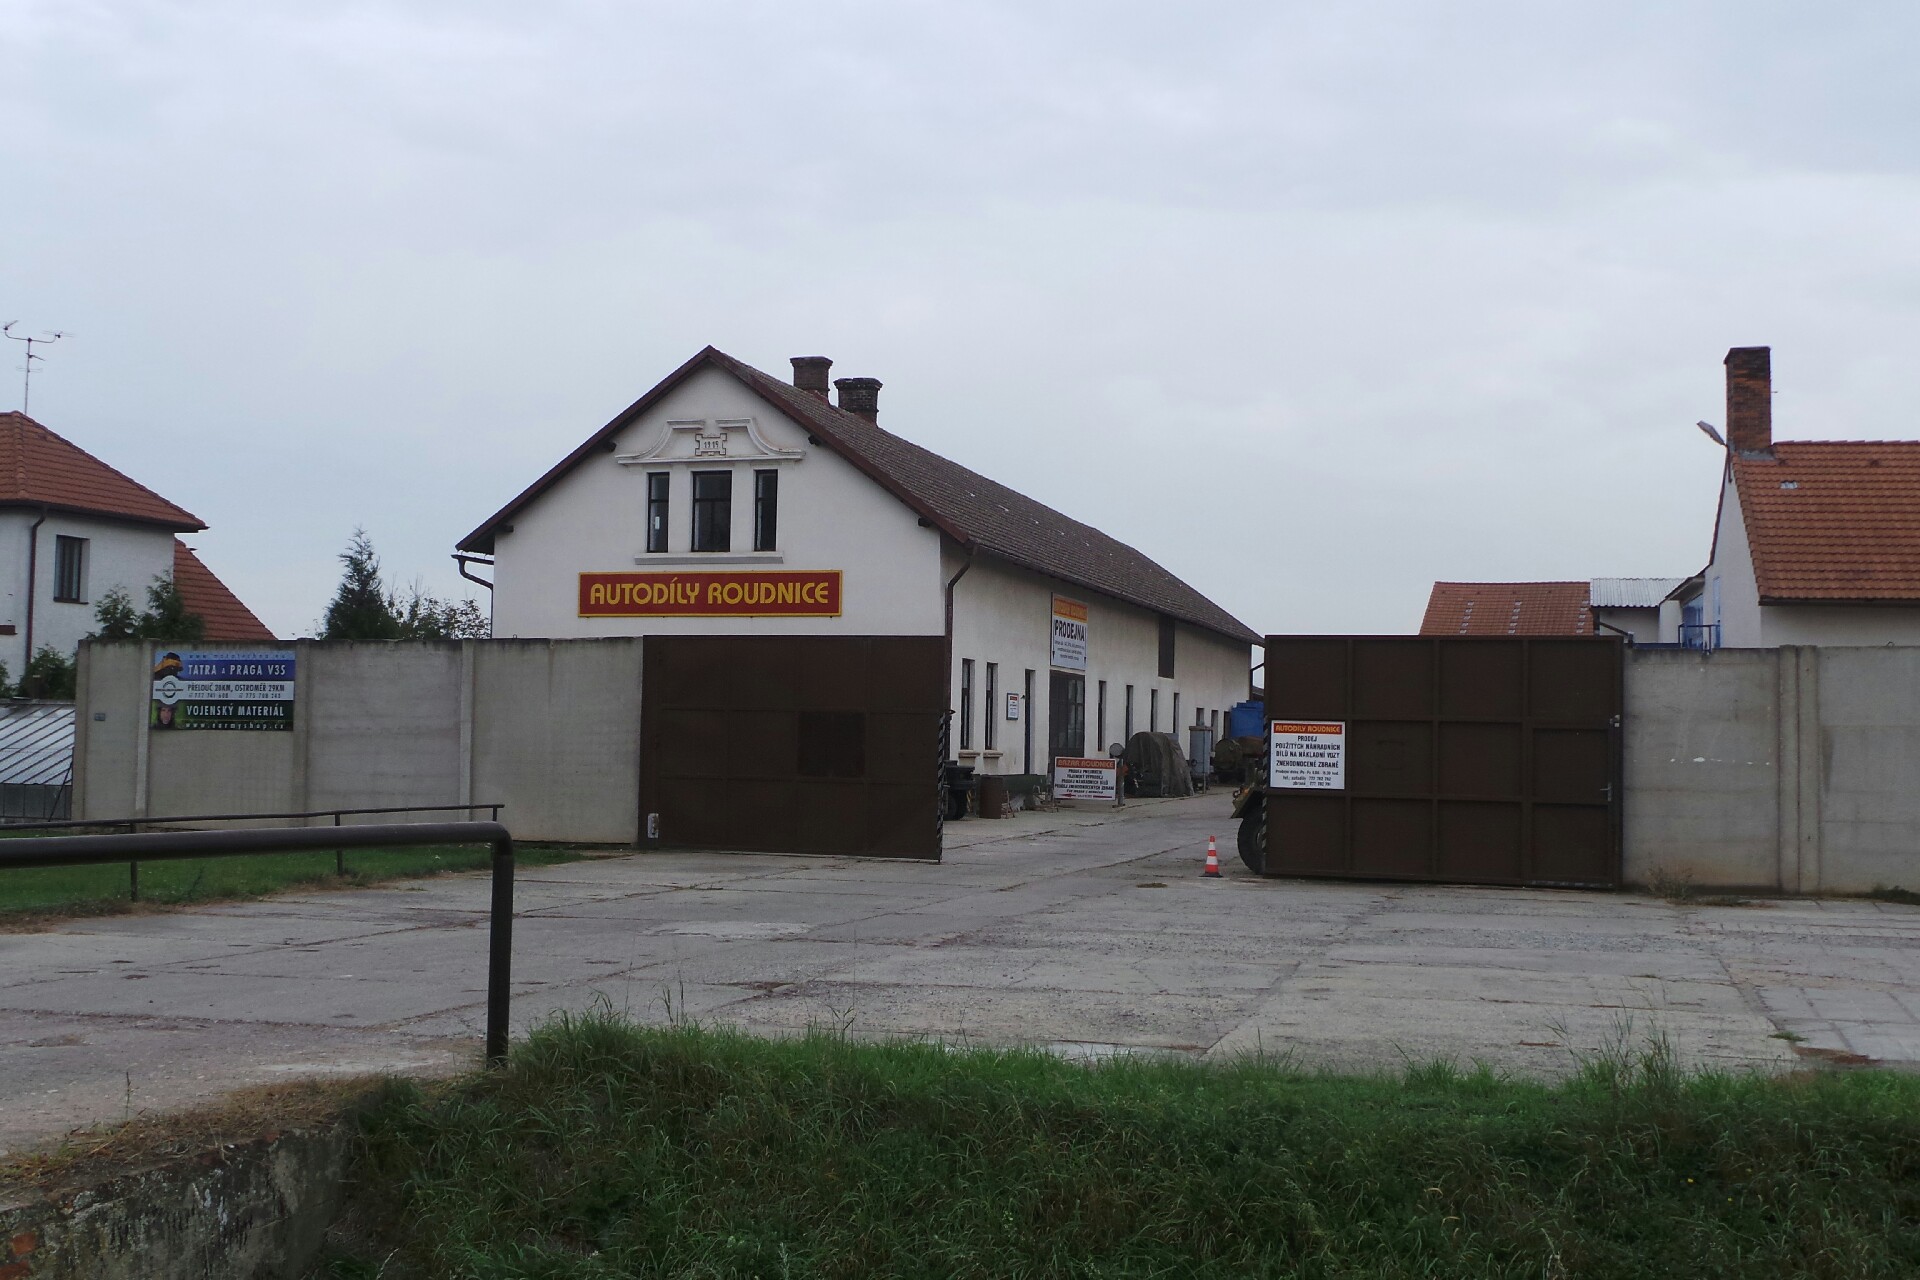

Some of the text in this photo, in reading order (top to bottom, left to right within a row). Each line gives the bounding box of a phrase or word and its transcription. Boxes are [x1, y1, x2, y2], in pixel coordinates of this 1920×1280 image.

[590, 577, 828, 604] AUTODÍLY ROUDNICE
[1055, 619, 1085, 642] PRODEJNA
[188, 664, 217, 675] TATRA
[229, 664, 263, 675] PRAGA
[267, 664, 286, 675] V3S
[186, 703, 284, 716] VOJENSKÝ MATERIÁL
